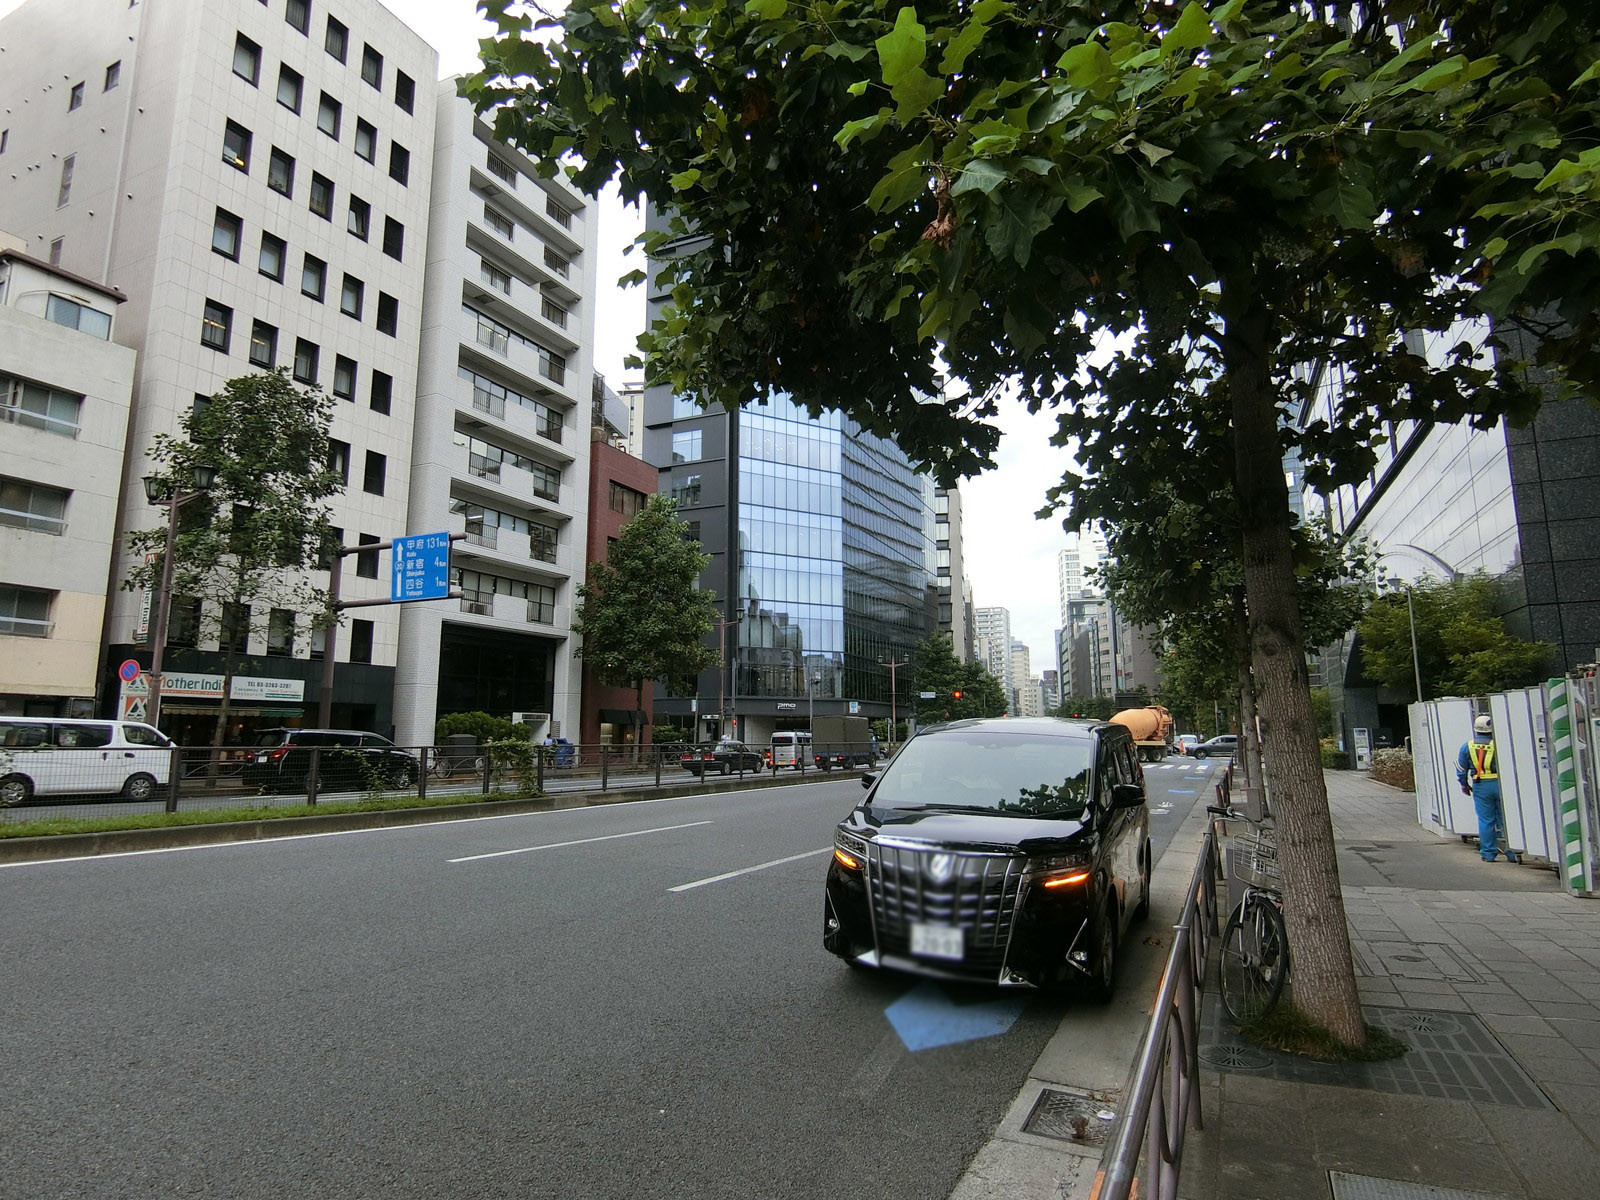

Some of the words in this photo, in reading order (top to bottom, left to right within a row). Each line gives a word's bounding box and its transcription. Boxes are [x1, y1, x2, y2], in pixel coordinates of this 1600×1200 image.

[407, 539, 424, 550] 甲府
[407, 559, 424, 570] 新宿
[406, 578, 424, 589] 四谷
[201, 678, 224, 690] Indi
